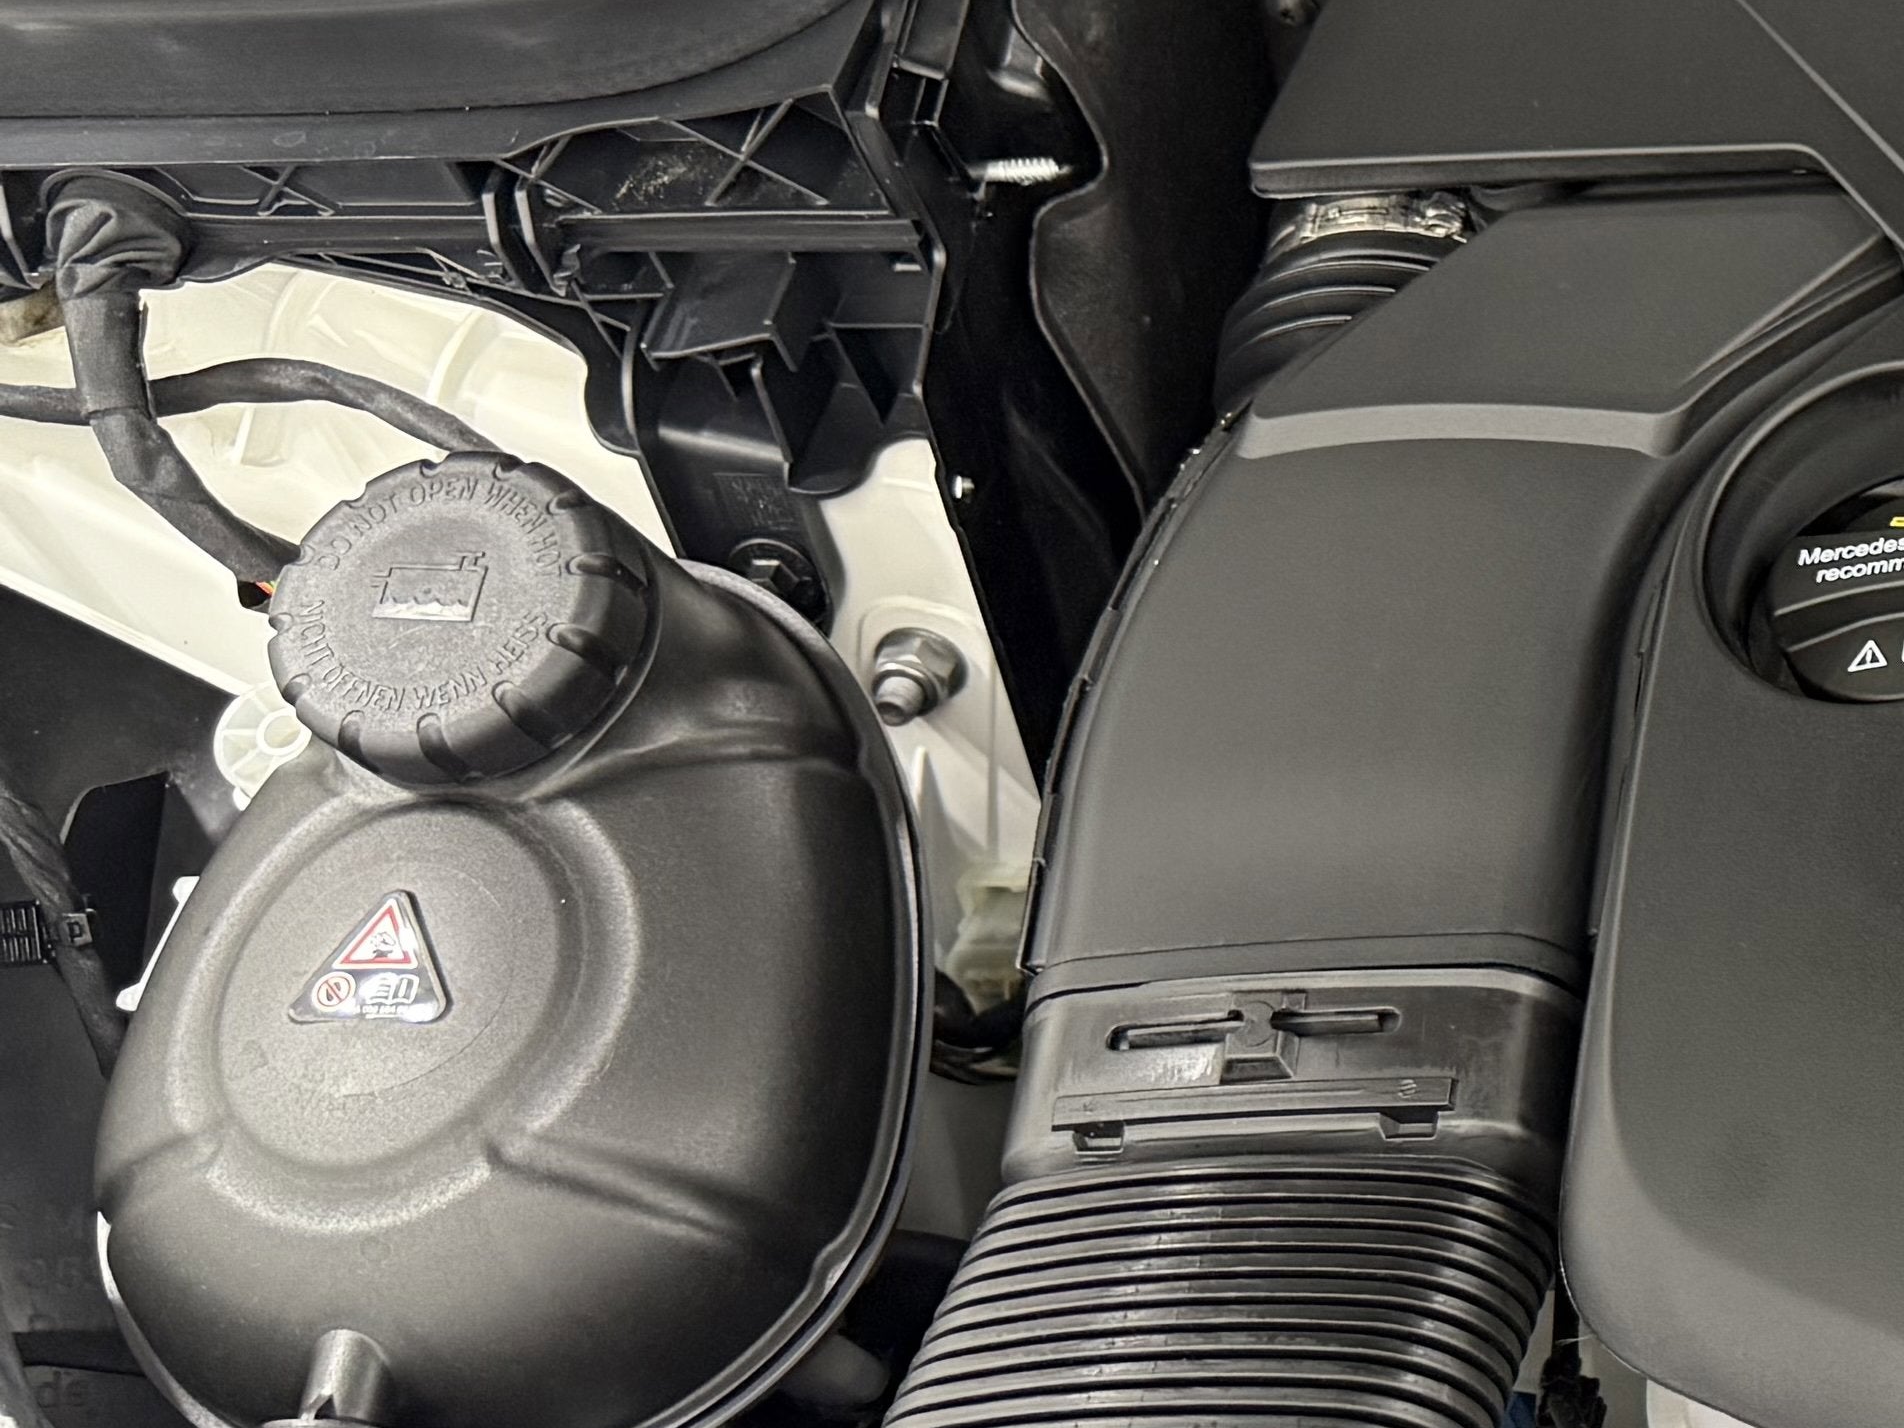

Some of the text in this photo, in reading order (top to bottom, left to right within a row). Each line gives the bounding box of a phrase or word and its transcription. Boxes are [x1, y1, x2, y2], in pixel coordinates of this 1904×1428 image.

[319, 476, 564, 578] DO NOT OPEN WHEN HOT
[300, 599, 336, 666] NICHT
[413, 669, 489, 710] WENN
